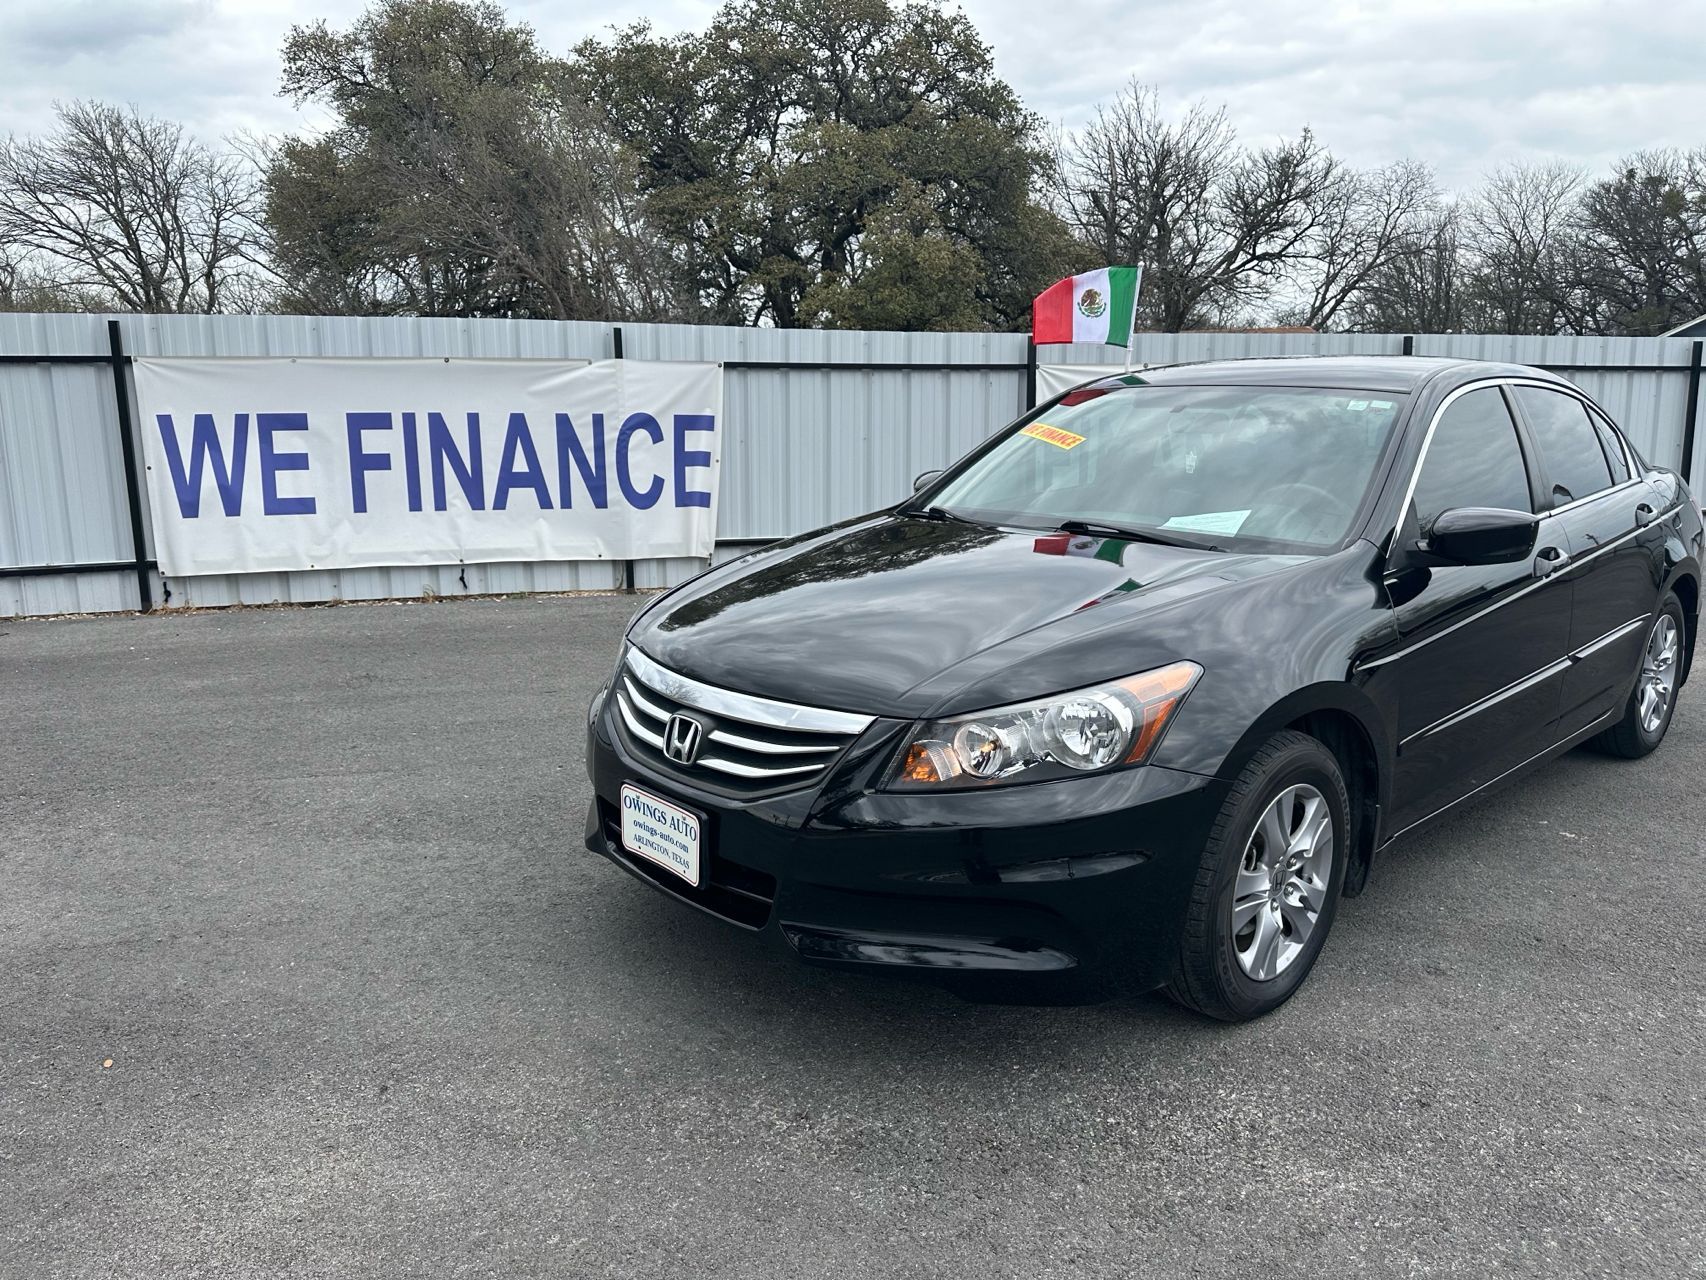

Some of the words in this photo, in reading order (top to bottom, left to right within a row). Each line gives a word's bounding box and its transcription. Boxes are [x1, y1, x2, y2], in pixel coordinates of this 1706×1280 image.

[1036, 427, 1082, 446] FINANCE
[156, 413, 317, 519] WE
[346, 412, 715, 514] FINANCE
[624, 795, 667, 825] OWINGS
[669, 816, 697, 841] AUTO
[633, 819, 689, 853] owings-auto.com
[633, 834, 670, 859] ARLINGTON,
[672, 851, 690, 870] TEXAS
